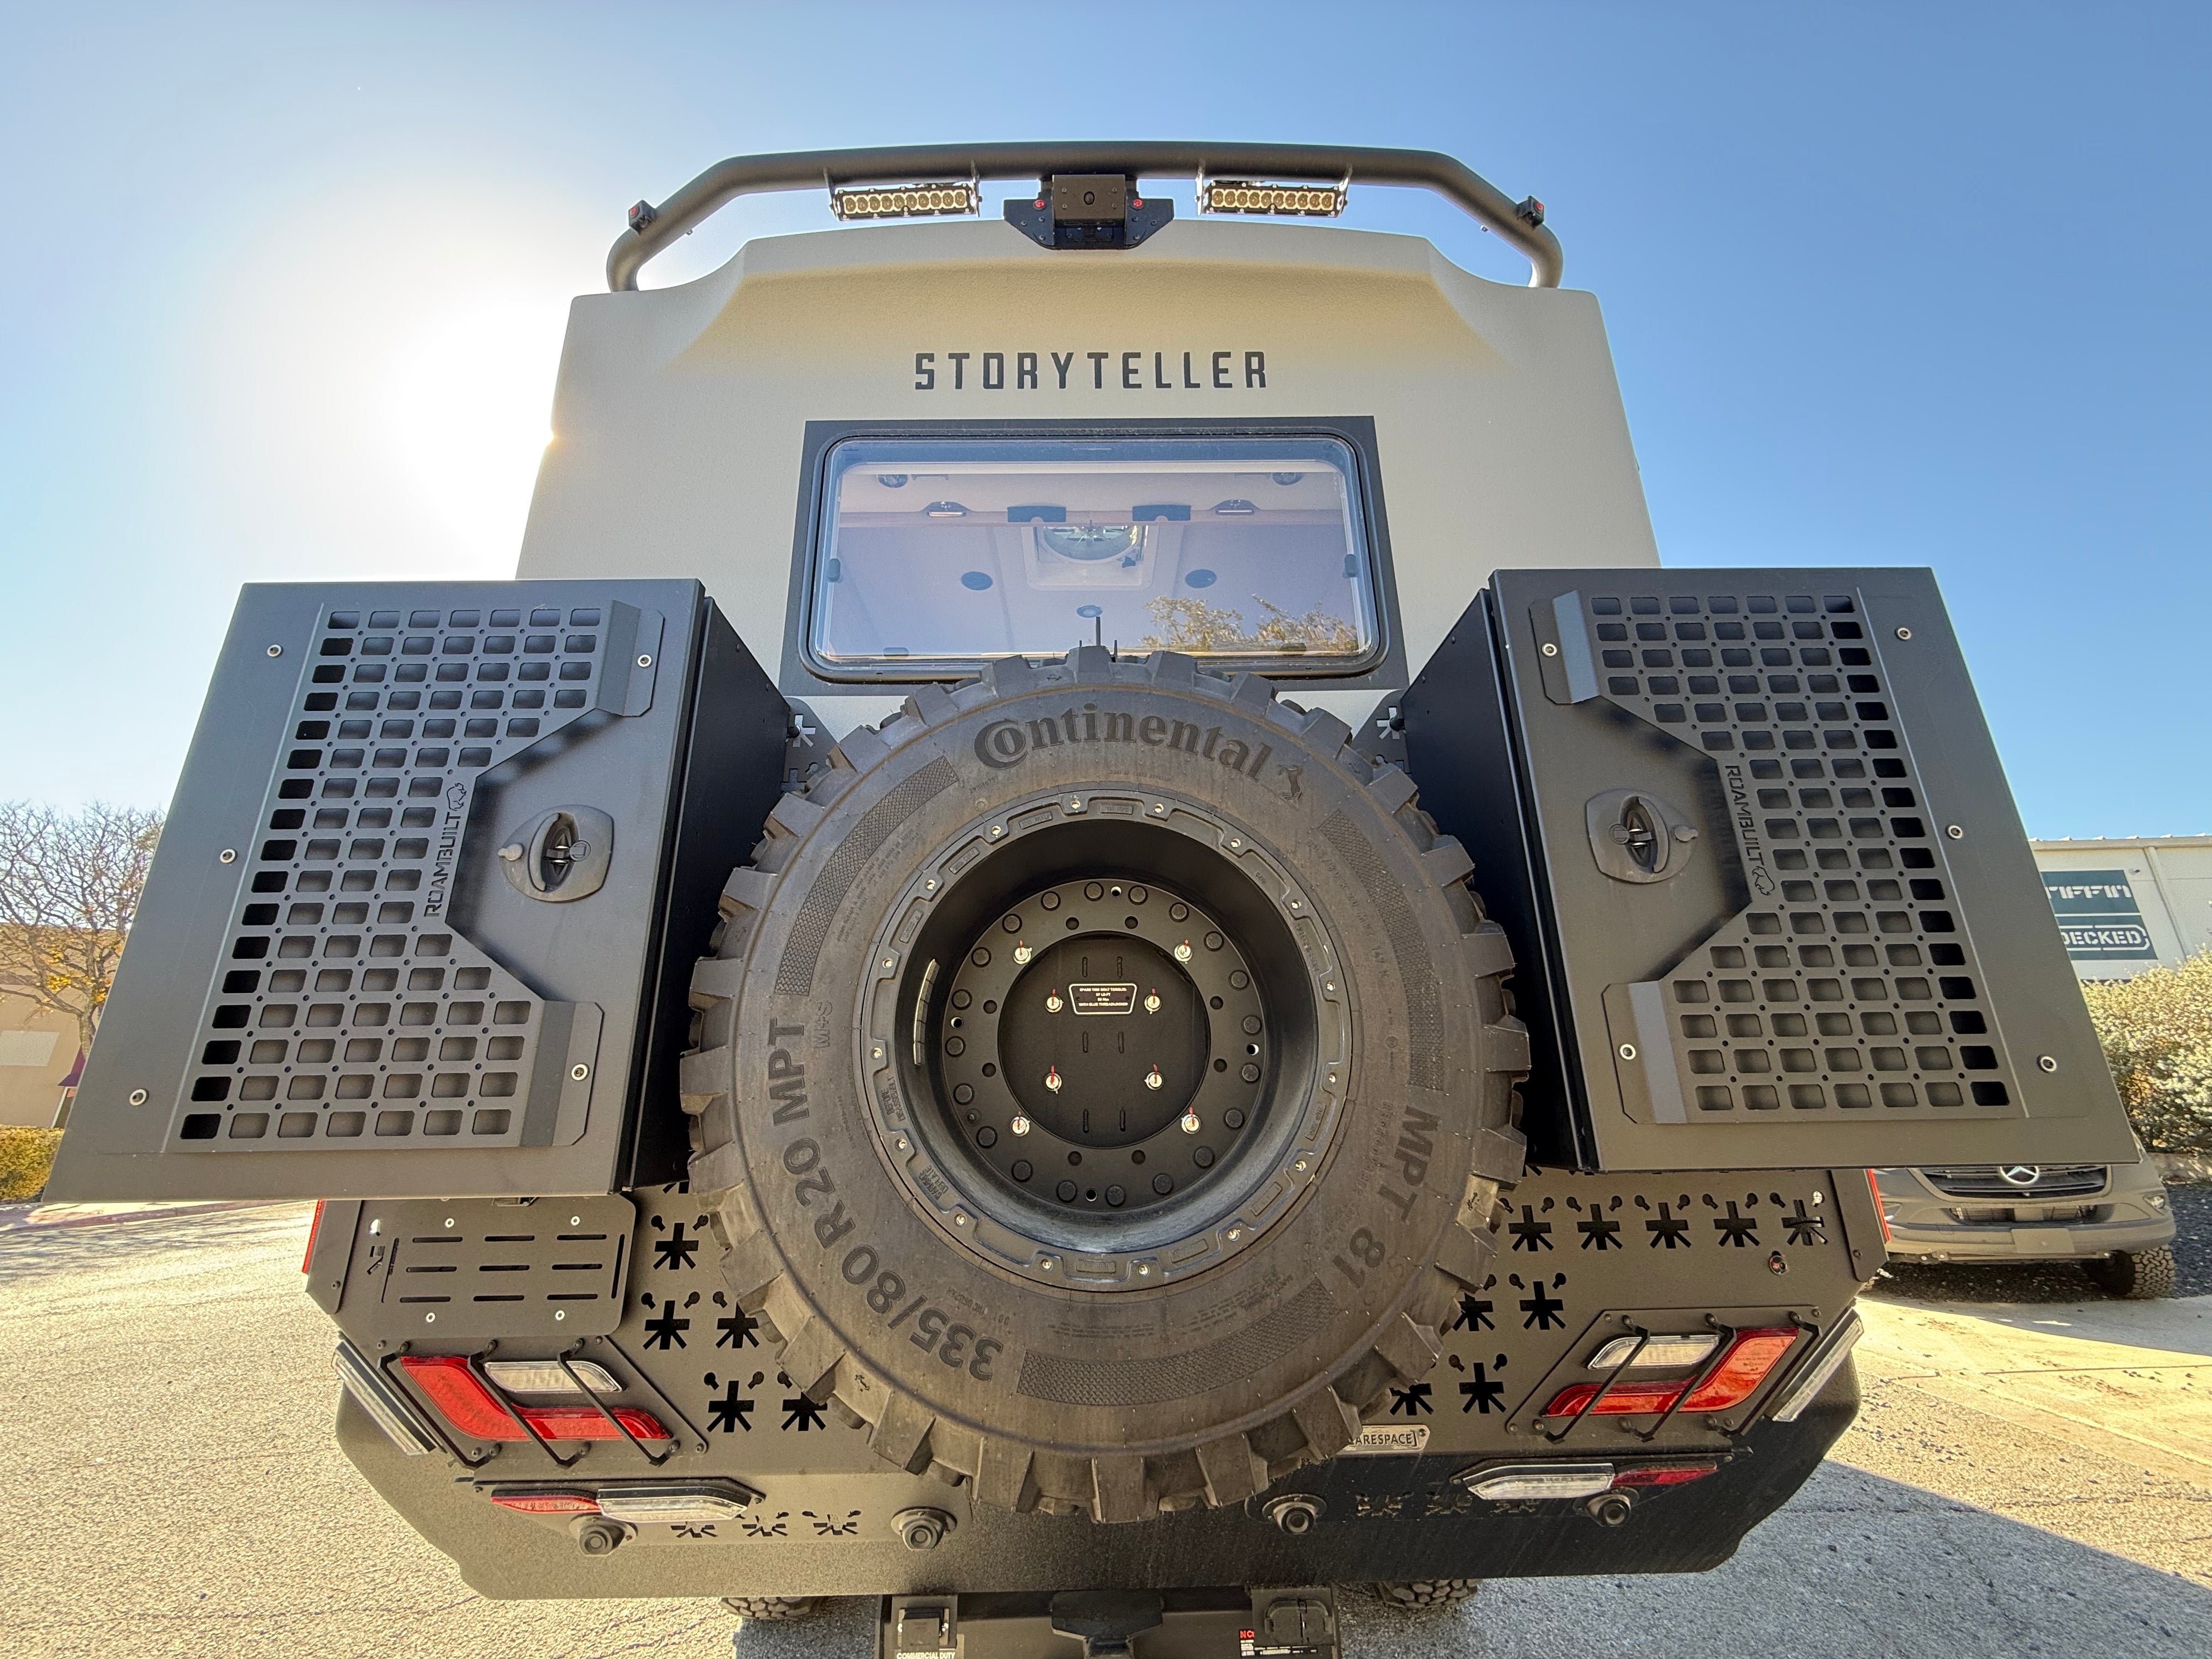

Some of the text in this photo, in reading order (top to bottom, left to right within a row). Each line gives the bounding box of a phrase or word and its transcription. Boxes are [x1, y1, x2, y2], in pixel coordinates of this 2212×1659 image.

[915, 352, 1267, 390] STORYTELLER
[974, 703, 1273, 783] Continental
[1725, 765, 1764, 866] ROAMBUILT
[424, 812, 461, 917] ROAMBUILT
[2061, 931, 2142, 945] DECKED
[811, 998, 833, 1048] M+S
[768, 1018, 809, 1126] MPT
[1377, 1105, 1440, 1222] MPT
[1333, 1228, 1386, 1288] 81
[842, 1245, 1003, 1381] 335/80
